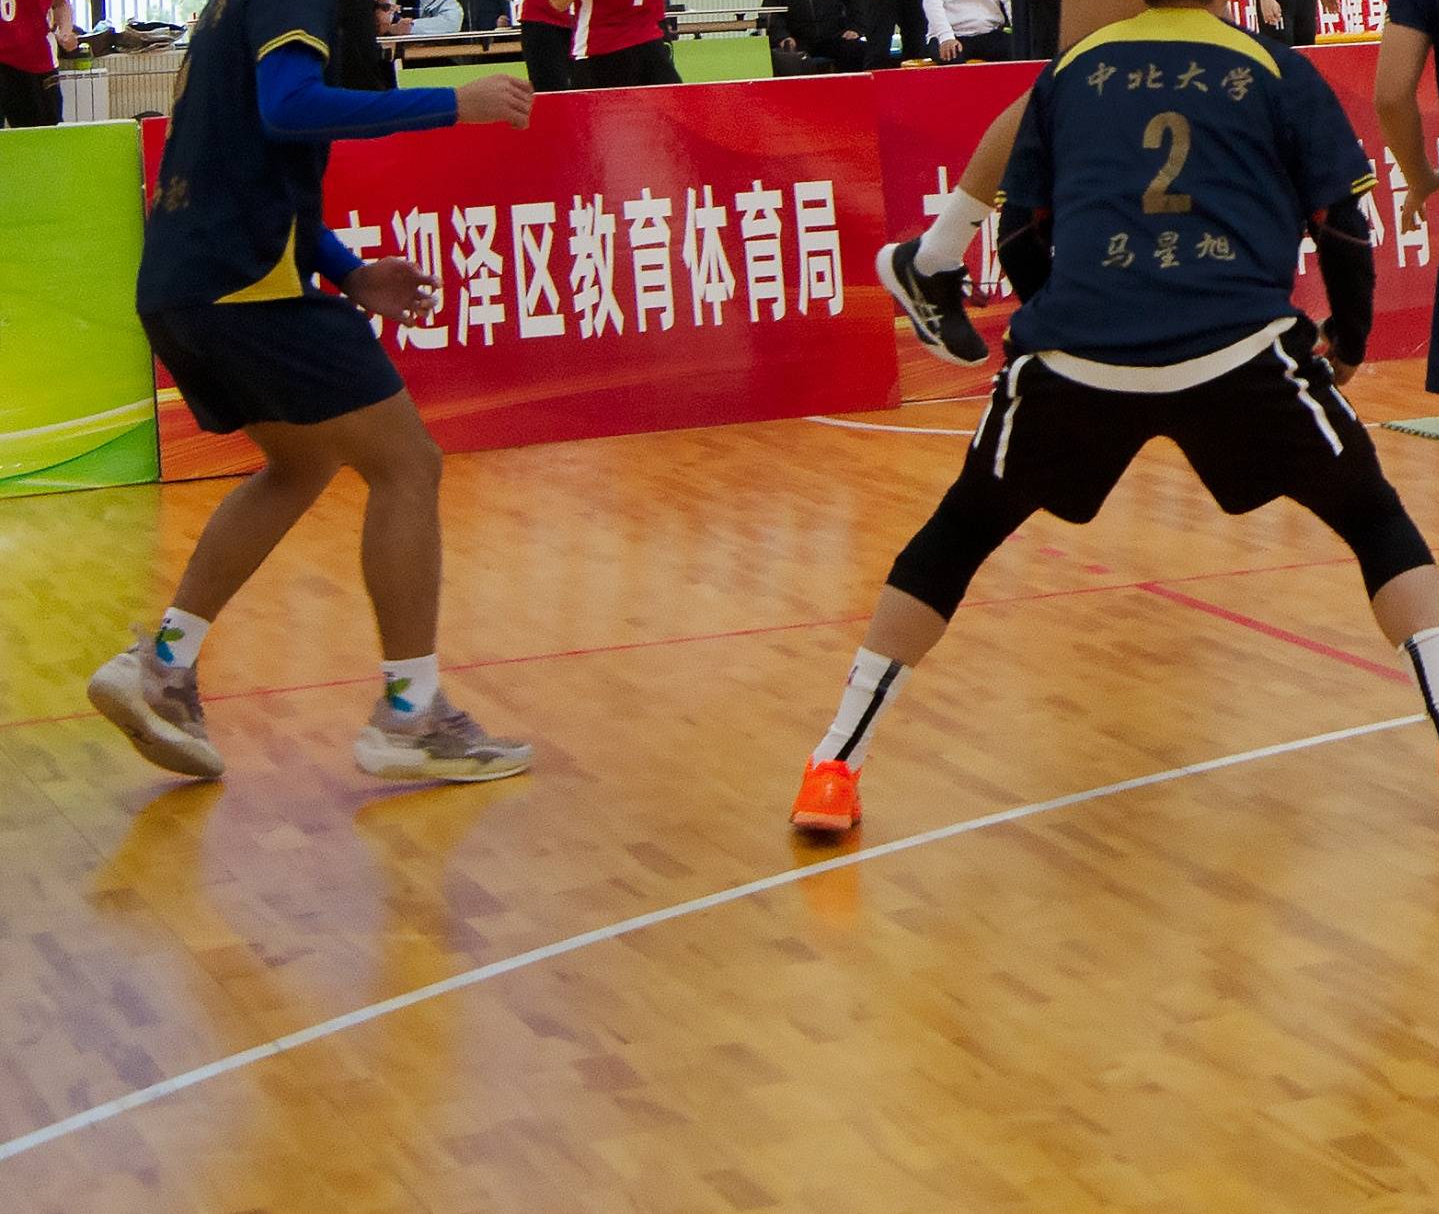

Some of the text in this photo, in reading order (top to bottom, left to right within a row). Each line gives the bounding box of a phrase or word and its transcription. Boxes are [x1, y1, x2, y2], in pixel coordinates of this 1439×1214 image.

[1086, 61, 1256, 103] 中北大学
[1141, 111, 1193, 216] 2
[1102, 232, 1238, 270] 马星旭
